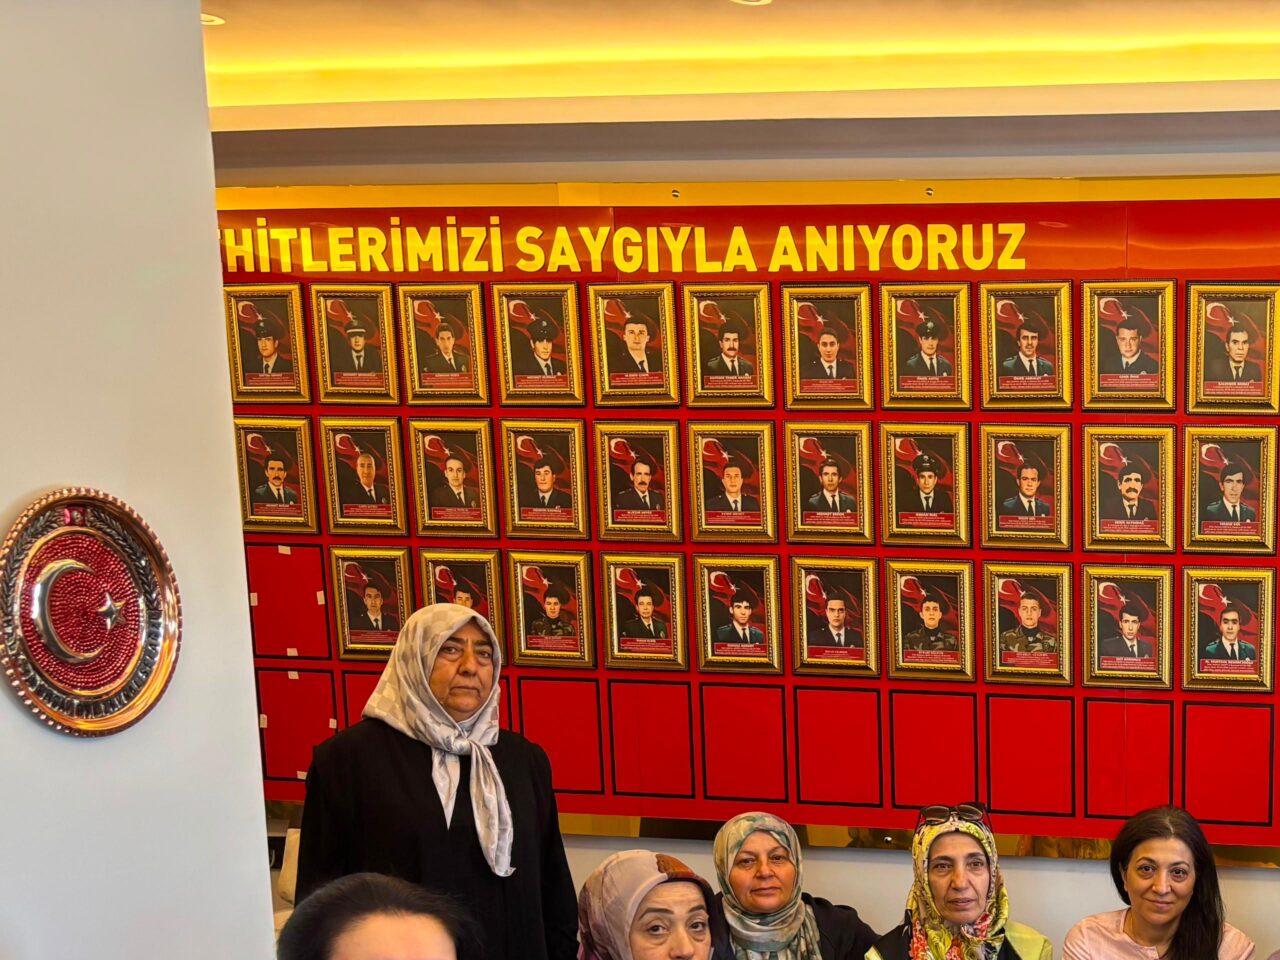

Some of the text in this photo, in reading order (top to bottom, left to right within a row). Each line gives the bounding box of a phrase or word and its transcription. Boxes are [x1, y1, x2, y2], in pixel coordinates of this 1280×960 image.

[217, 217, 1025, 272] HİTLERİMİZİ SAYGIYLA ANIYORUZ
